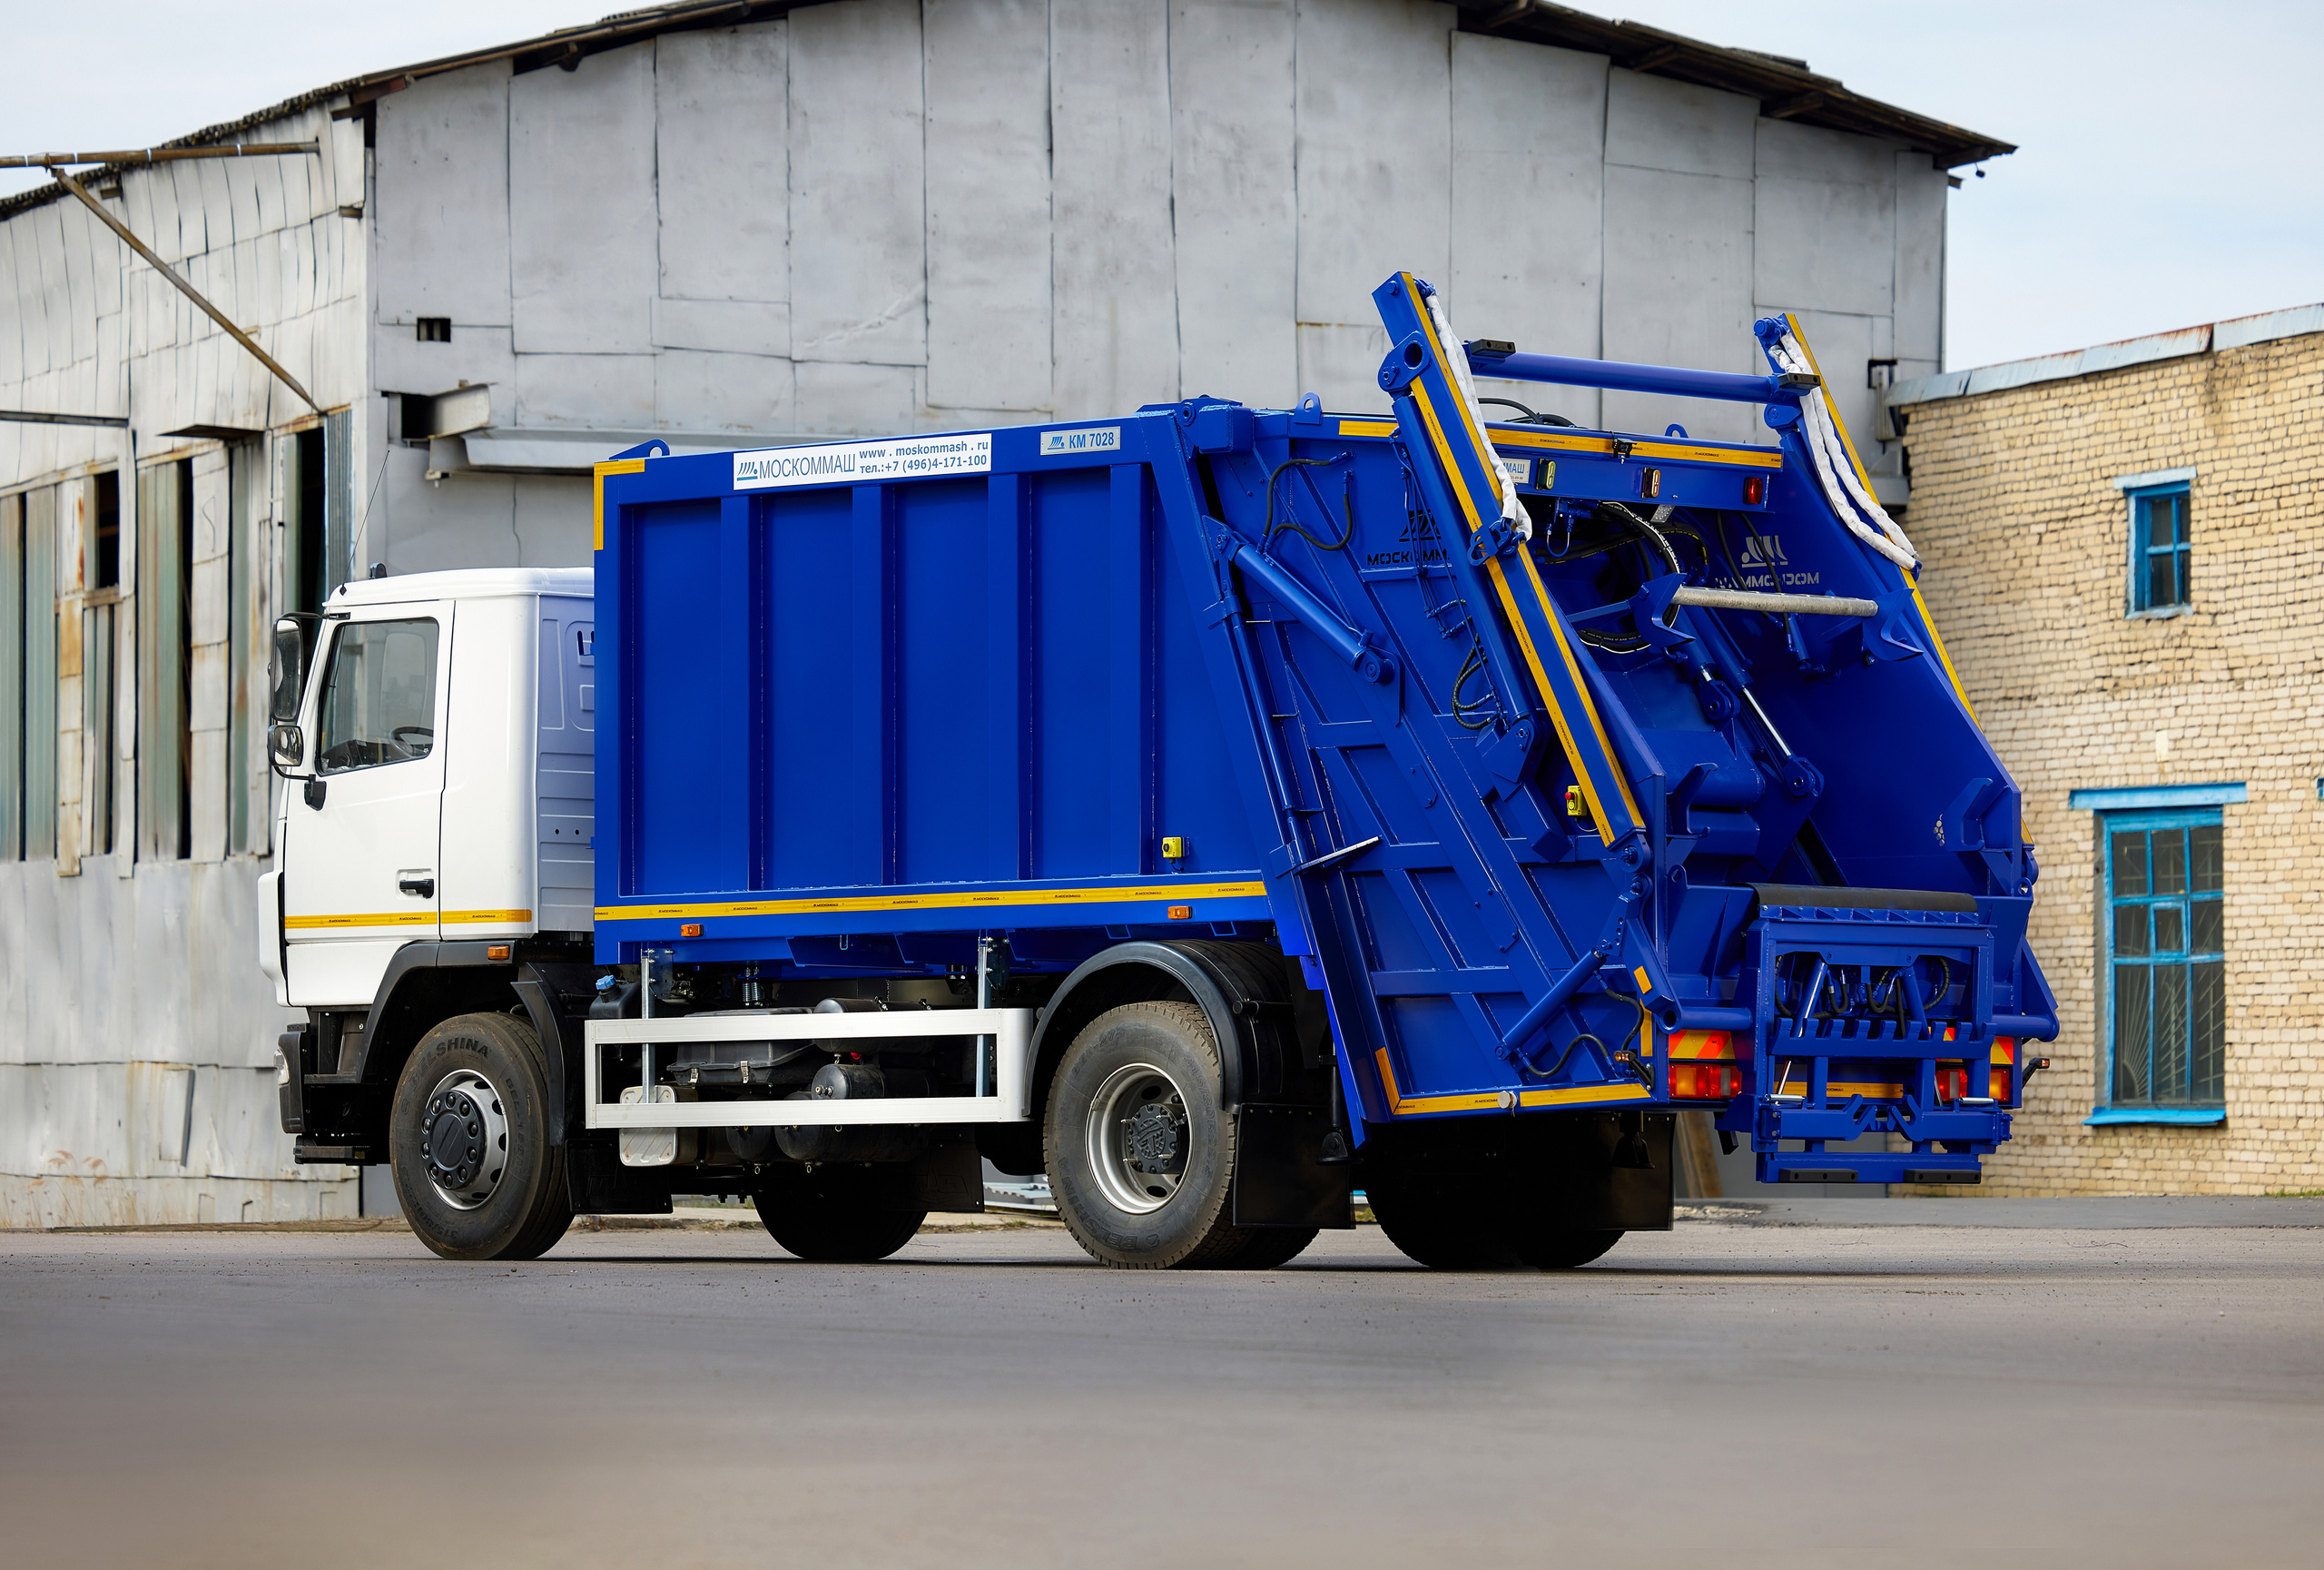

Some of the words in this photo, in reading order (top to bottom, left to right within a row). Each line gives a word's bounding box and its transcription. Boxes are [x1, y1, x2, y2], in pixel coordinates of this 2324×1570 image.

[859, 449, 886, 459] www
[895, 440, 968, 457] moskommash
[977, 441, 989, 450] ru
[1089, 432, 1114, 447] 7028
[759, 453, 856, 479] МОСКОММАШ
[902, 455, 987, 473] (496)4-171-100
[409, 1037, 488, 1091] BELSHINA
[1058, 1156, 1138, 1249] BELSHINA
